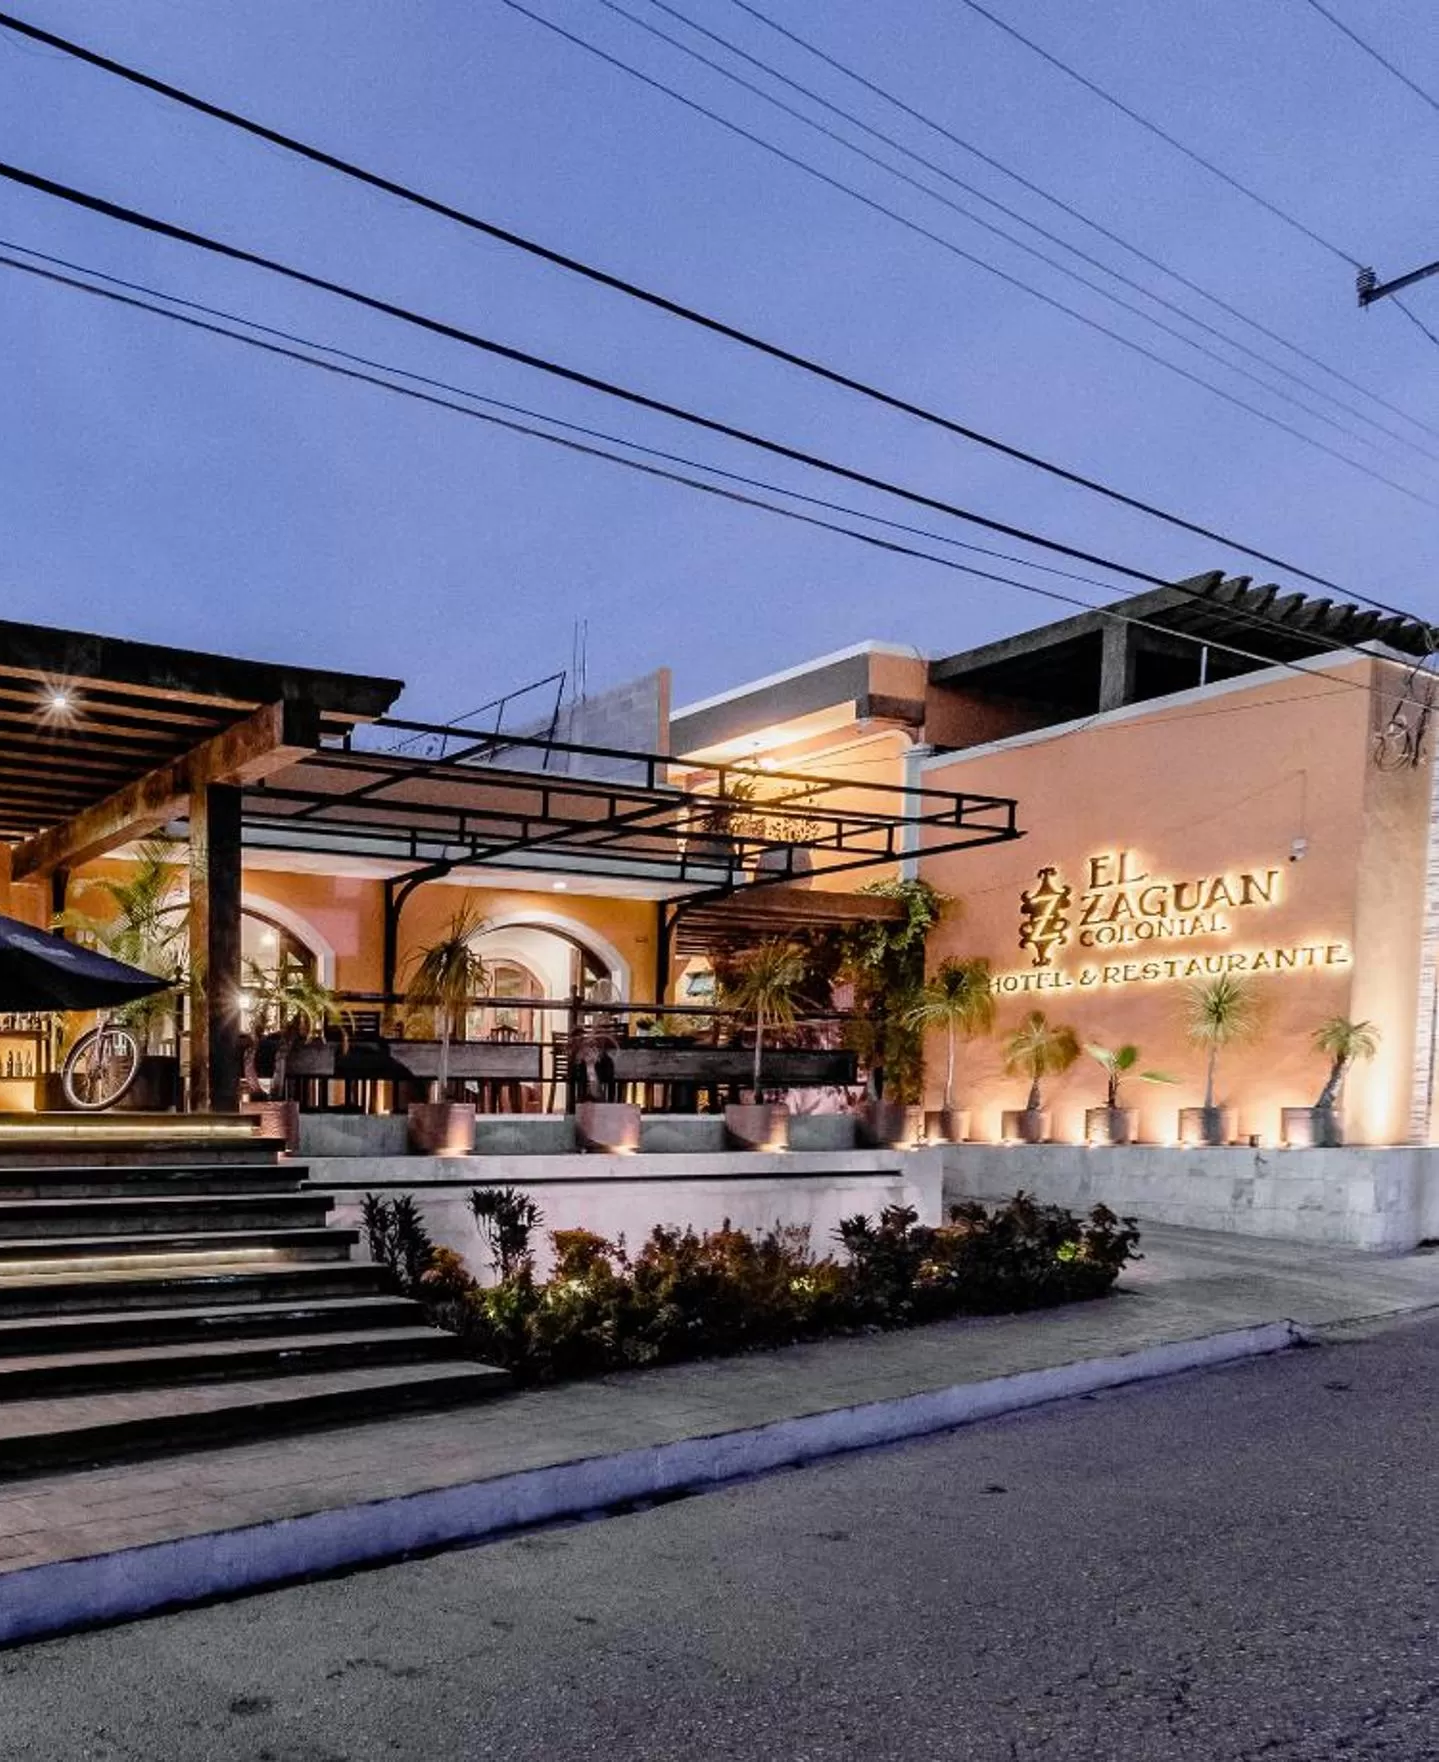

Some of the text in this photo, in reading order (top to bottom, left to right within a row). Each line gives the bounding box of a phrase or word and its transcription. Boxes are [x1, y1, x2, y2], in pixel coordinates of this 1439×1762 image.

[1089, 853, 1148, 889] EL
[1079, 871, 1279, 926] ZAGUAN
[1079, 913, 1227, 947] COLONIAL
[988, 945, 1348, 993] HOTEL & RESTAURANTE
